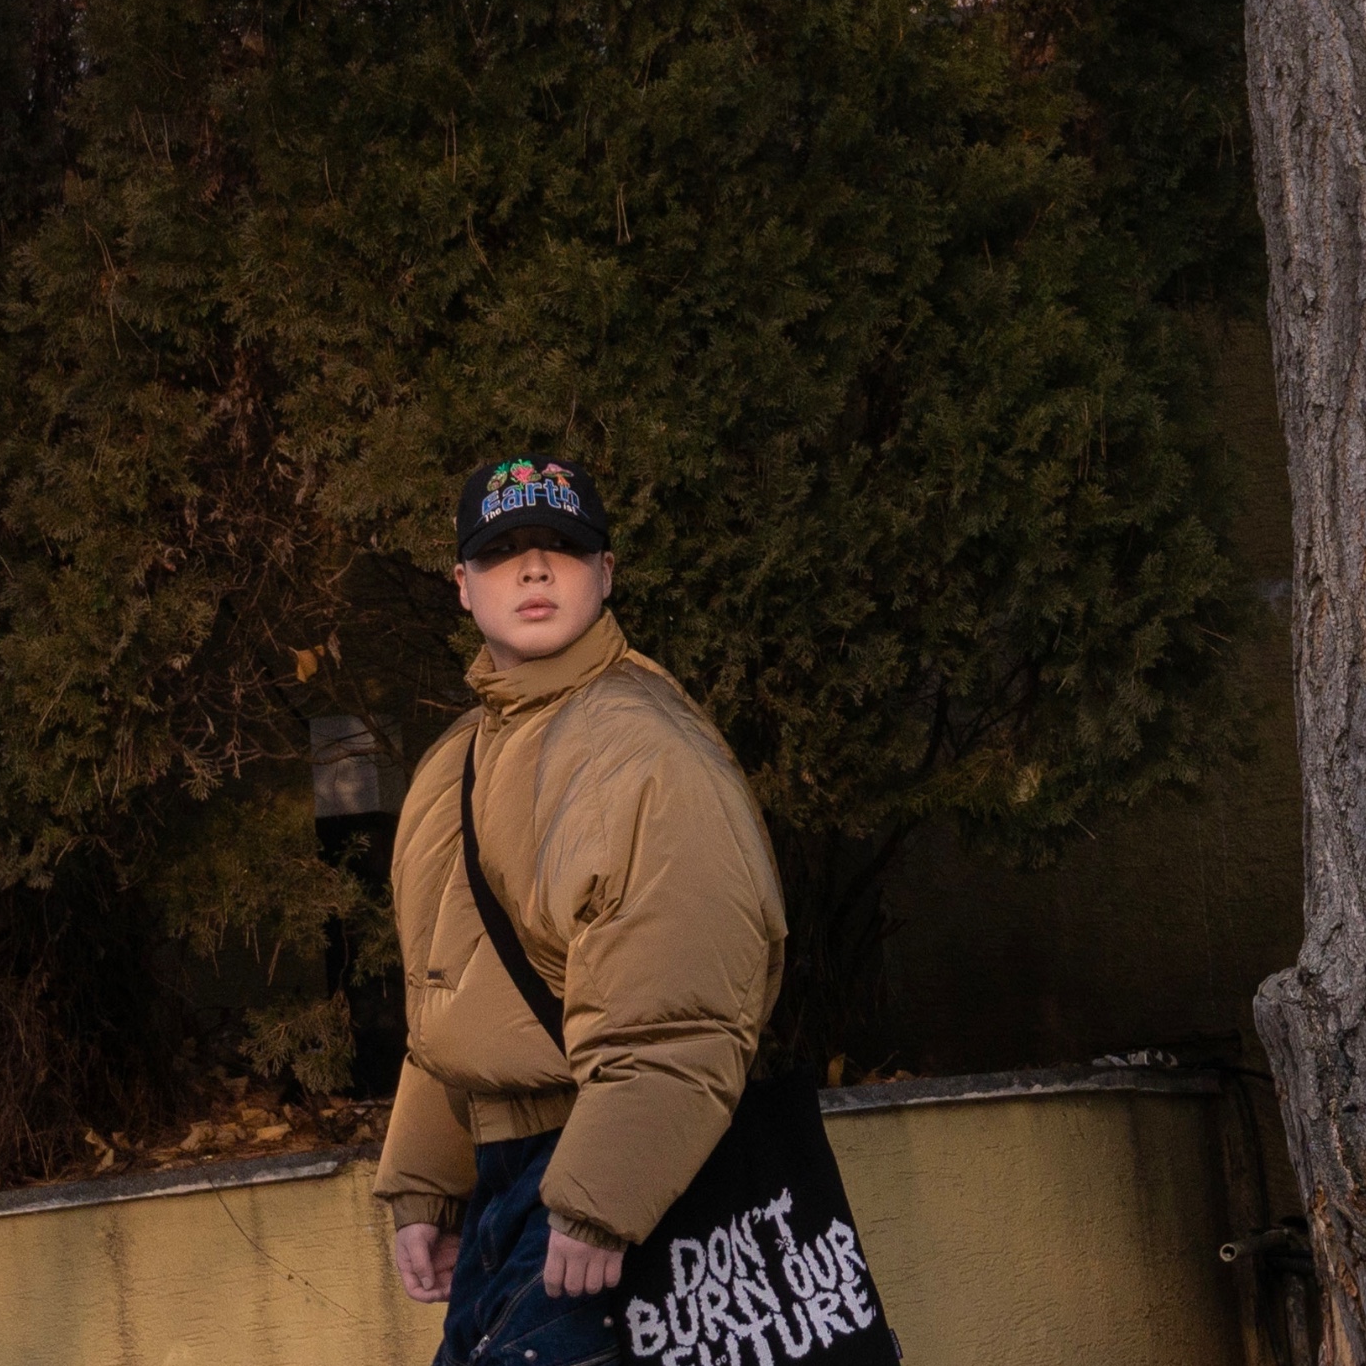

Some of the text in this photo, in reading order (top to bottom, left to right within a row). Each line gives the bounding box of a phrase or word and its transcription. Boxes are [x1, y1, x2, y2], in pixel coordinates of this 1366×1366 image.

[626, 1216, 866, 1357] BURN OUR
[669, 1187, 797, 1298] DON'T
